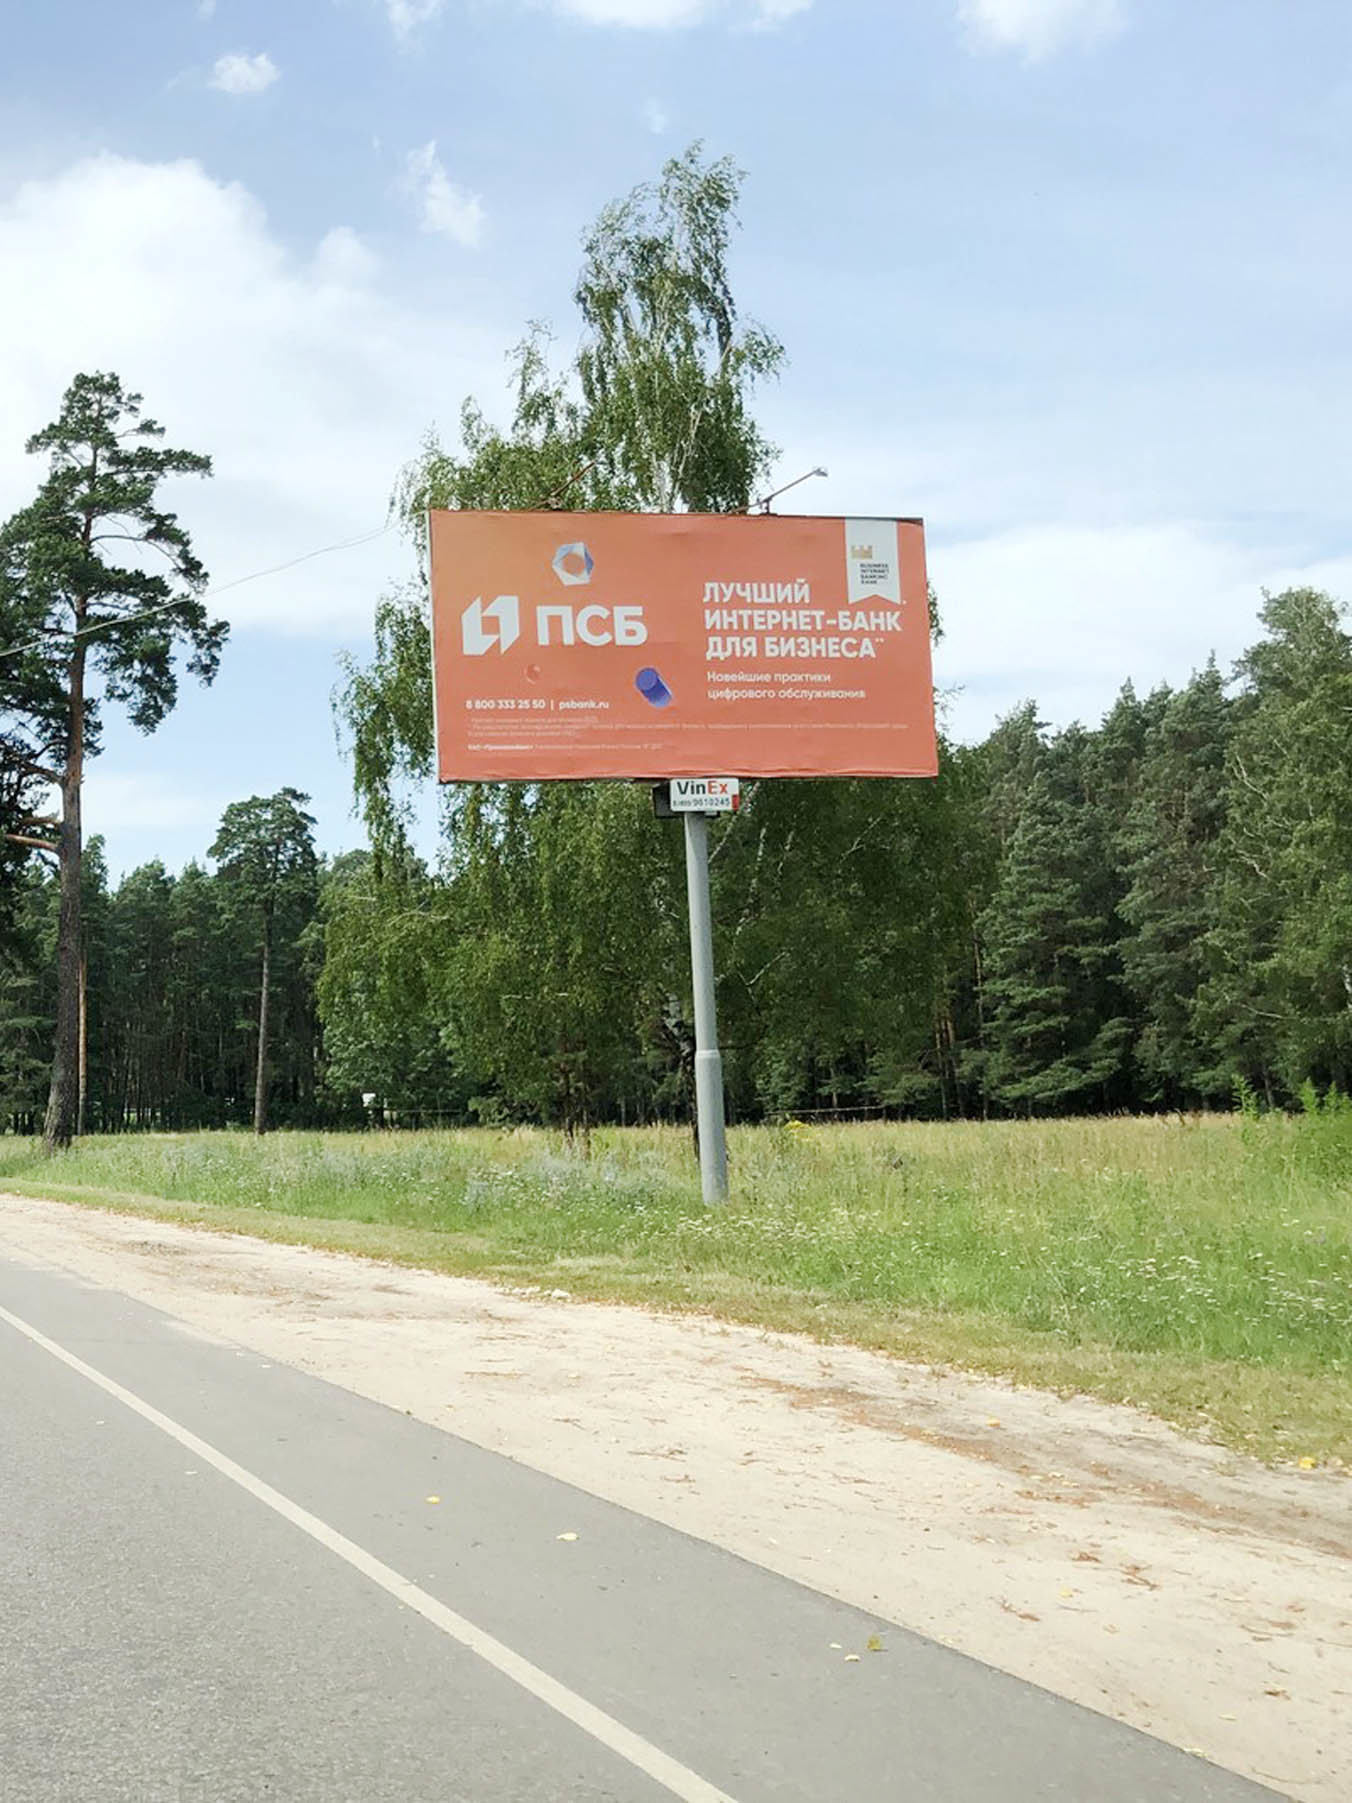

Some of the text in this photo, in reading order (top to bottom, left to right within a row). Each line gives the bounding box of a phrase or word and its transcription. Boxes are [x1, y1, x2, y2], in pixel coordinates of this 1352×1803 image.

[703, 578, 811, 604] ЛУЧШИЙ
[536, 604, 648, 646] ПСБ
[704, 609, 903, 632] ИНТЕРНЕТ-БАНК
[706, 636, 758, 661] ДЛЯ
[707, 671, 832, 684] Новейшие практики
[707, 687, 866, 701] цифрового обслуживания
[466, 699, 610, 712] 8 800 333 25 50 psbank.ru
[677, 780, 729, 795] VinEx
